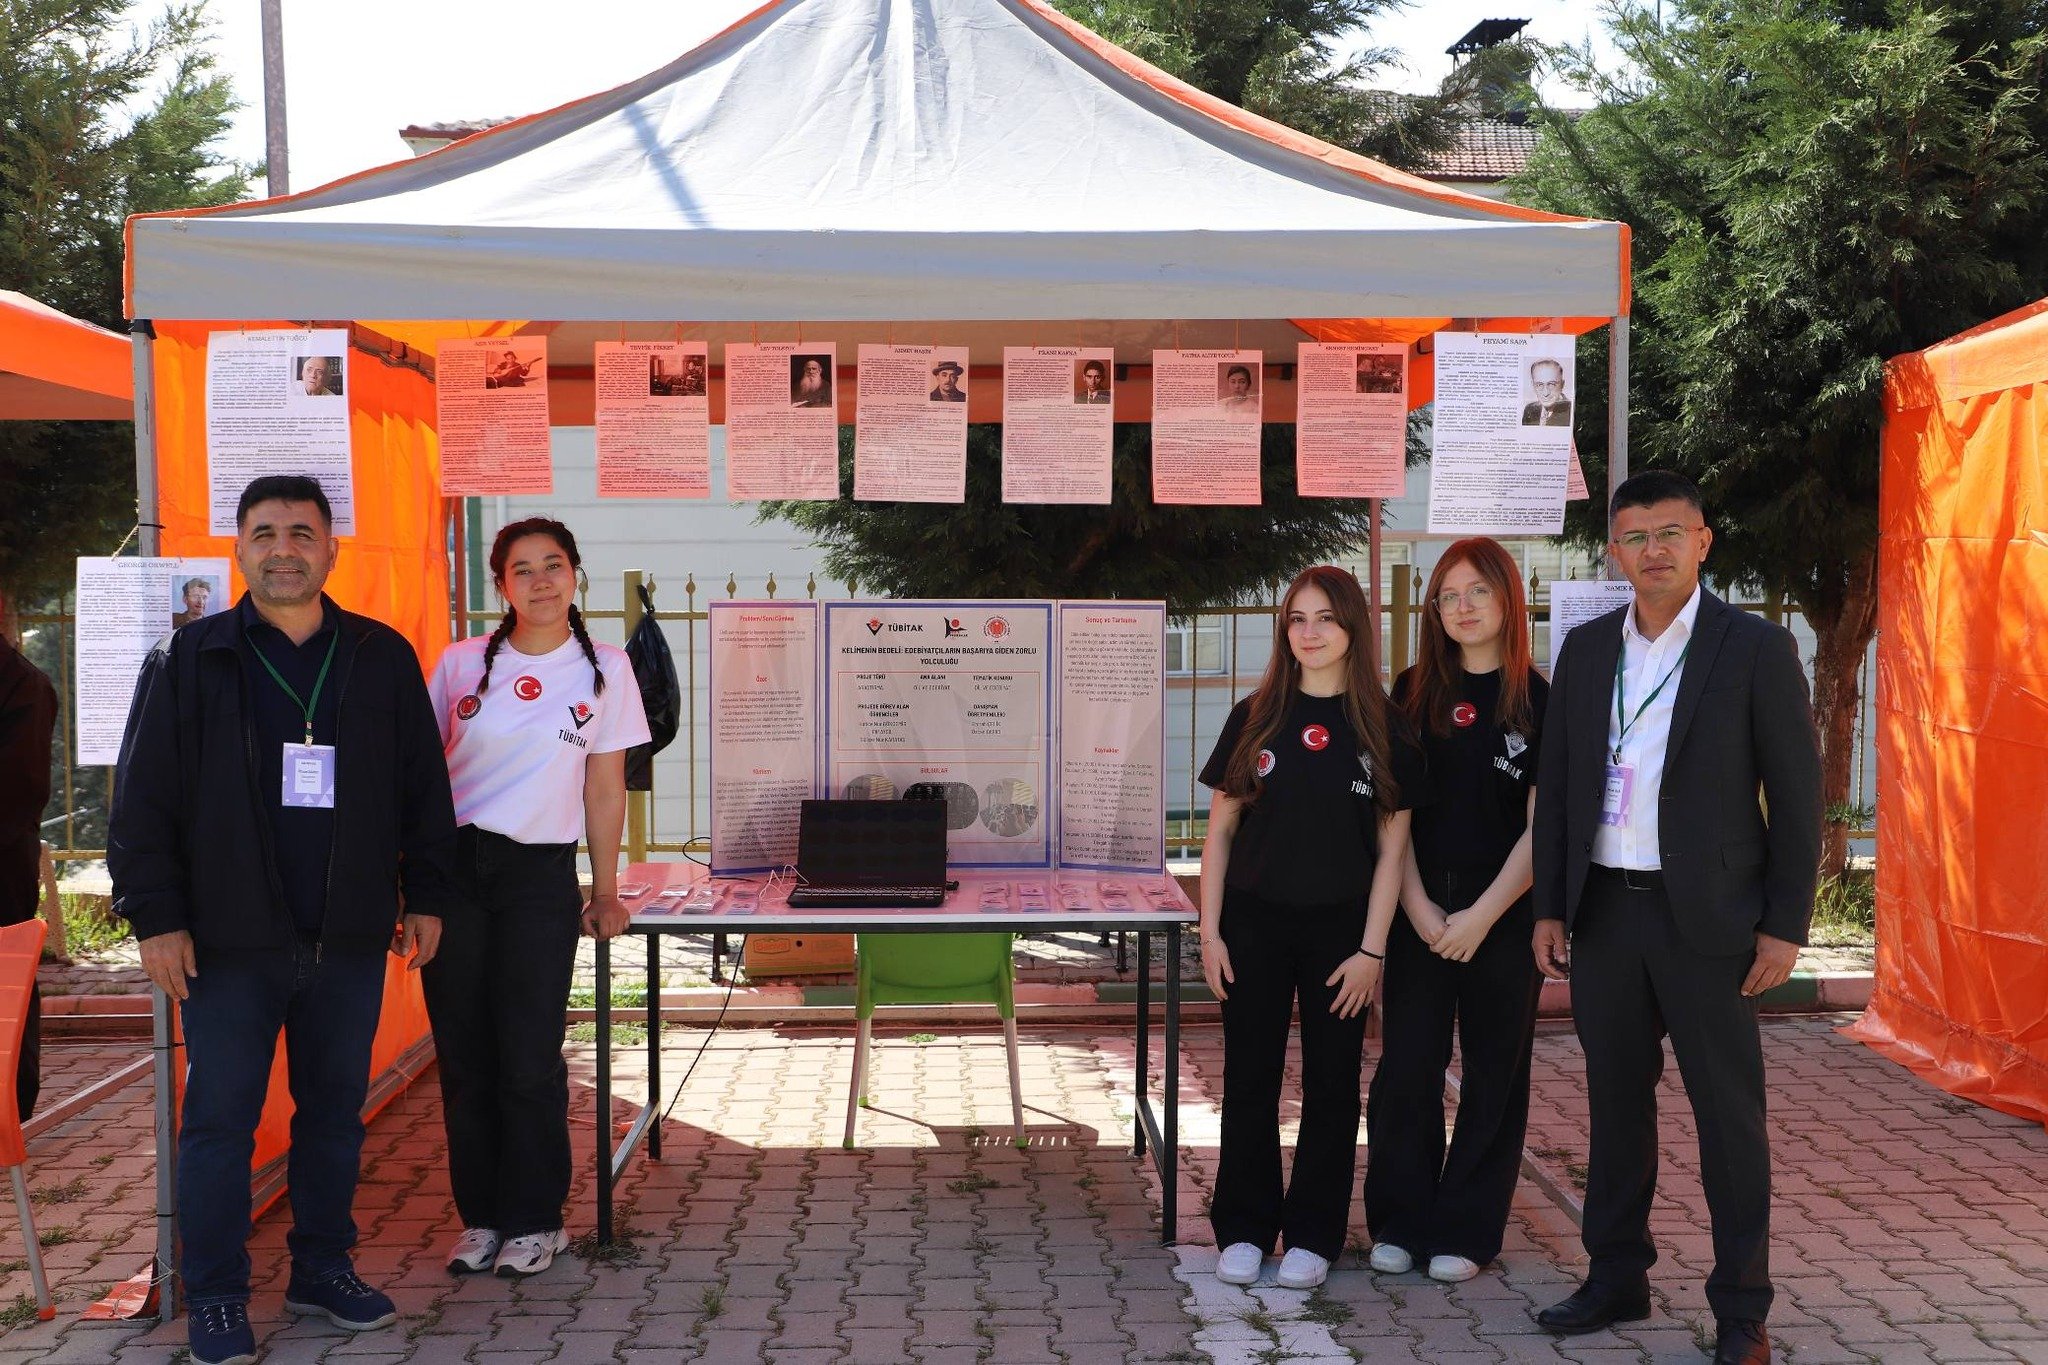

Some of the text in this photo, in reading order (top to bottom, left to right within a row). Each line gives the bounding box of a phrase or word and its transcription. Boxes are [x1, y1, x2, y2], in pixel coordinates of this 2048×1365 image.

[1085, 616, 1104, 625] Sonuç
[888, 621, 924, 632] TÜBİTAK
[841, 645, 877, 655] KELİMENİN
[904, 646, 961, 656] EDEBİYATÇILARIN
[962, 646, 994, 656] BAŞARIYA
[994, 647, 1015, 655] GİDEN
[920, 656, 959, 666] YOLCULUĞU
[558, 729, 588, 749] TÜBİTAK
